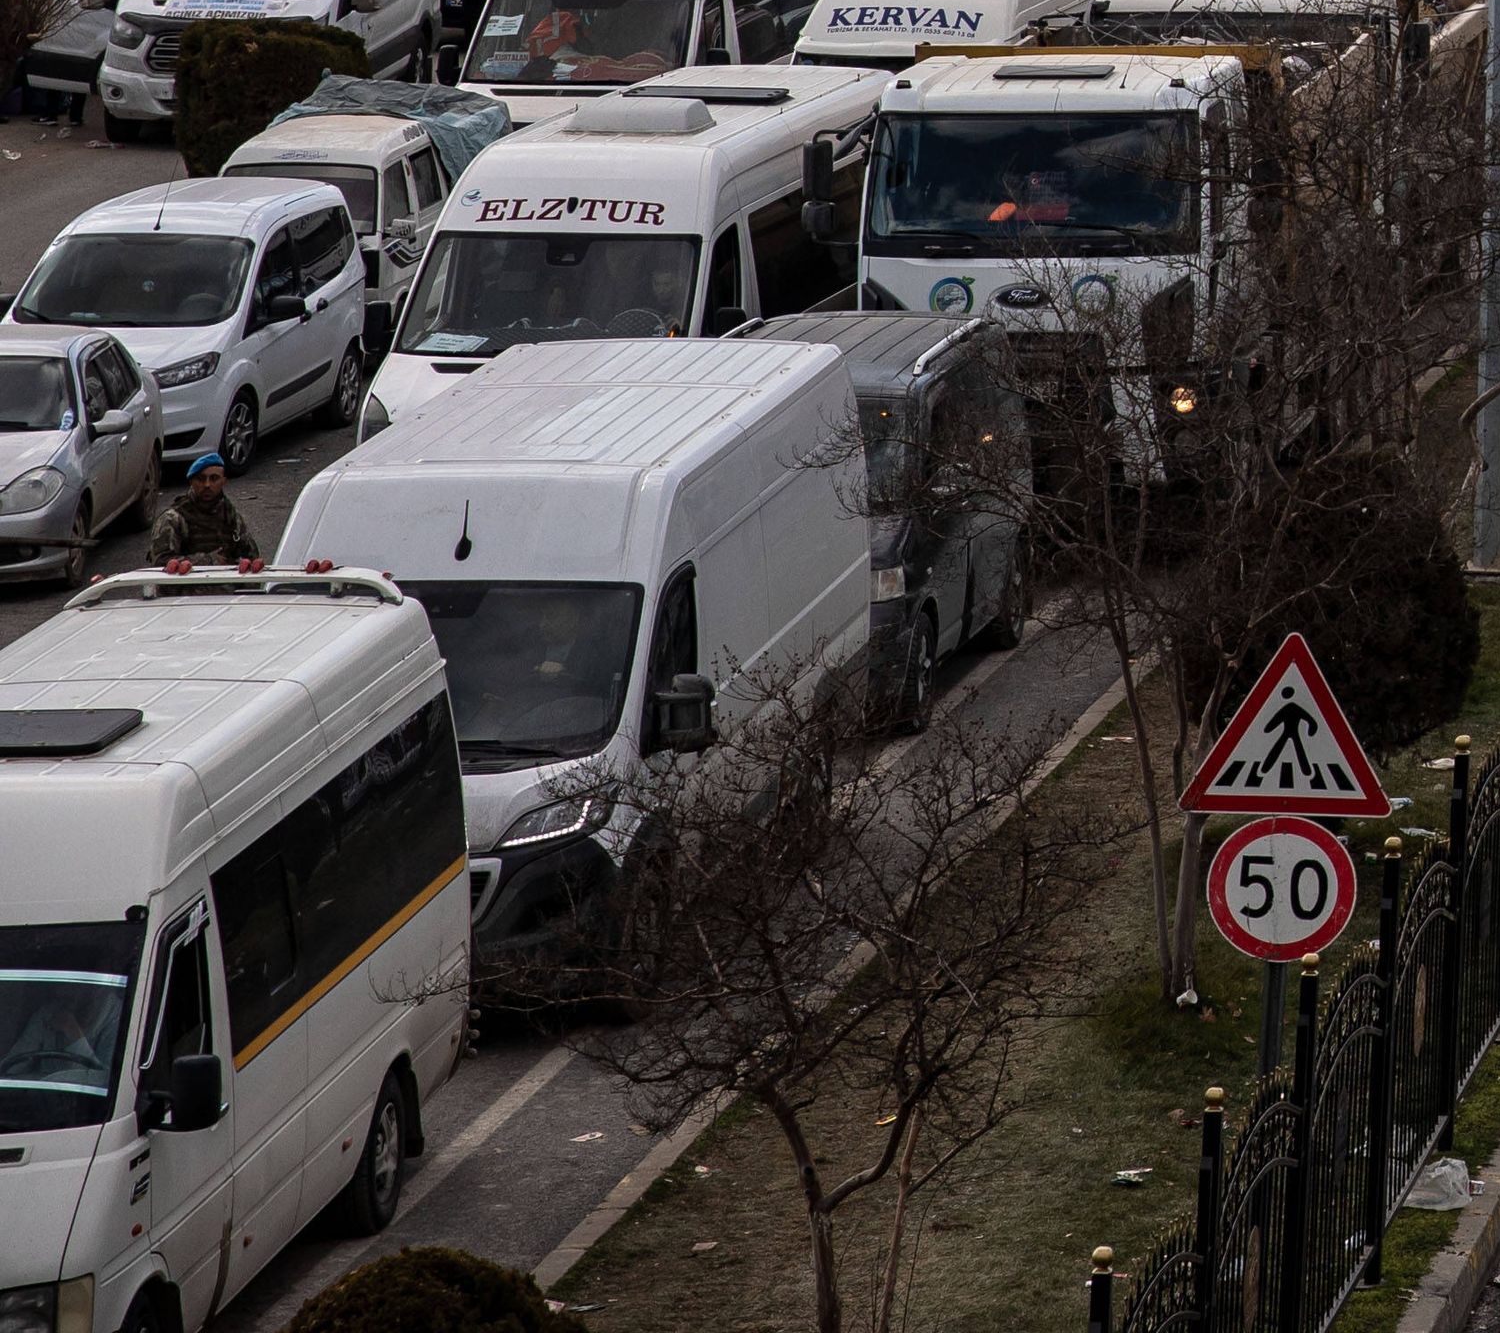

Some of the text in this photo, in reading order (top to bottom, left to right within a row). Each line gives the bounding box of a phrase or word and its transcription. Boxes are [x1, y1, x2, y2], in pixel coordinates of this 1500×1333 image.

[827, 6, 984, 32] KERVAN
[475, 198, 665, 226] ELZ TUR
[1007, 289, 1039, 302] Ford
[1240, 855, 1329, 920] 50
